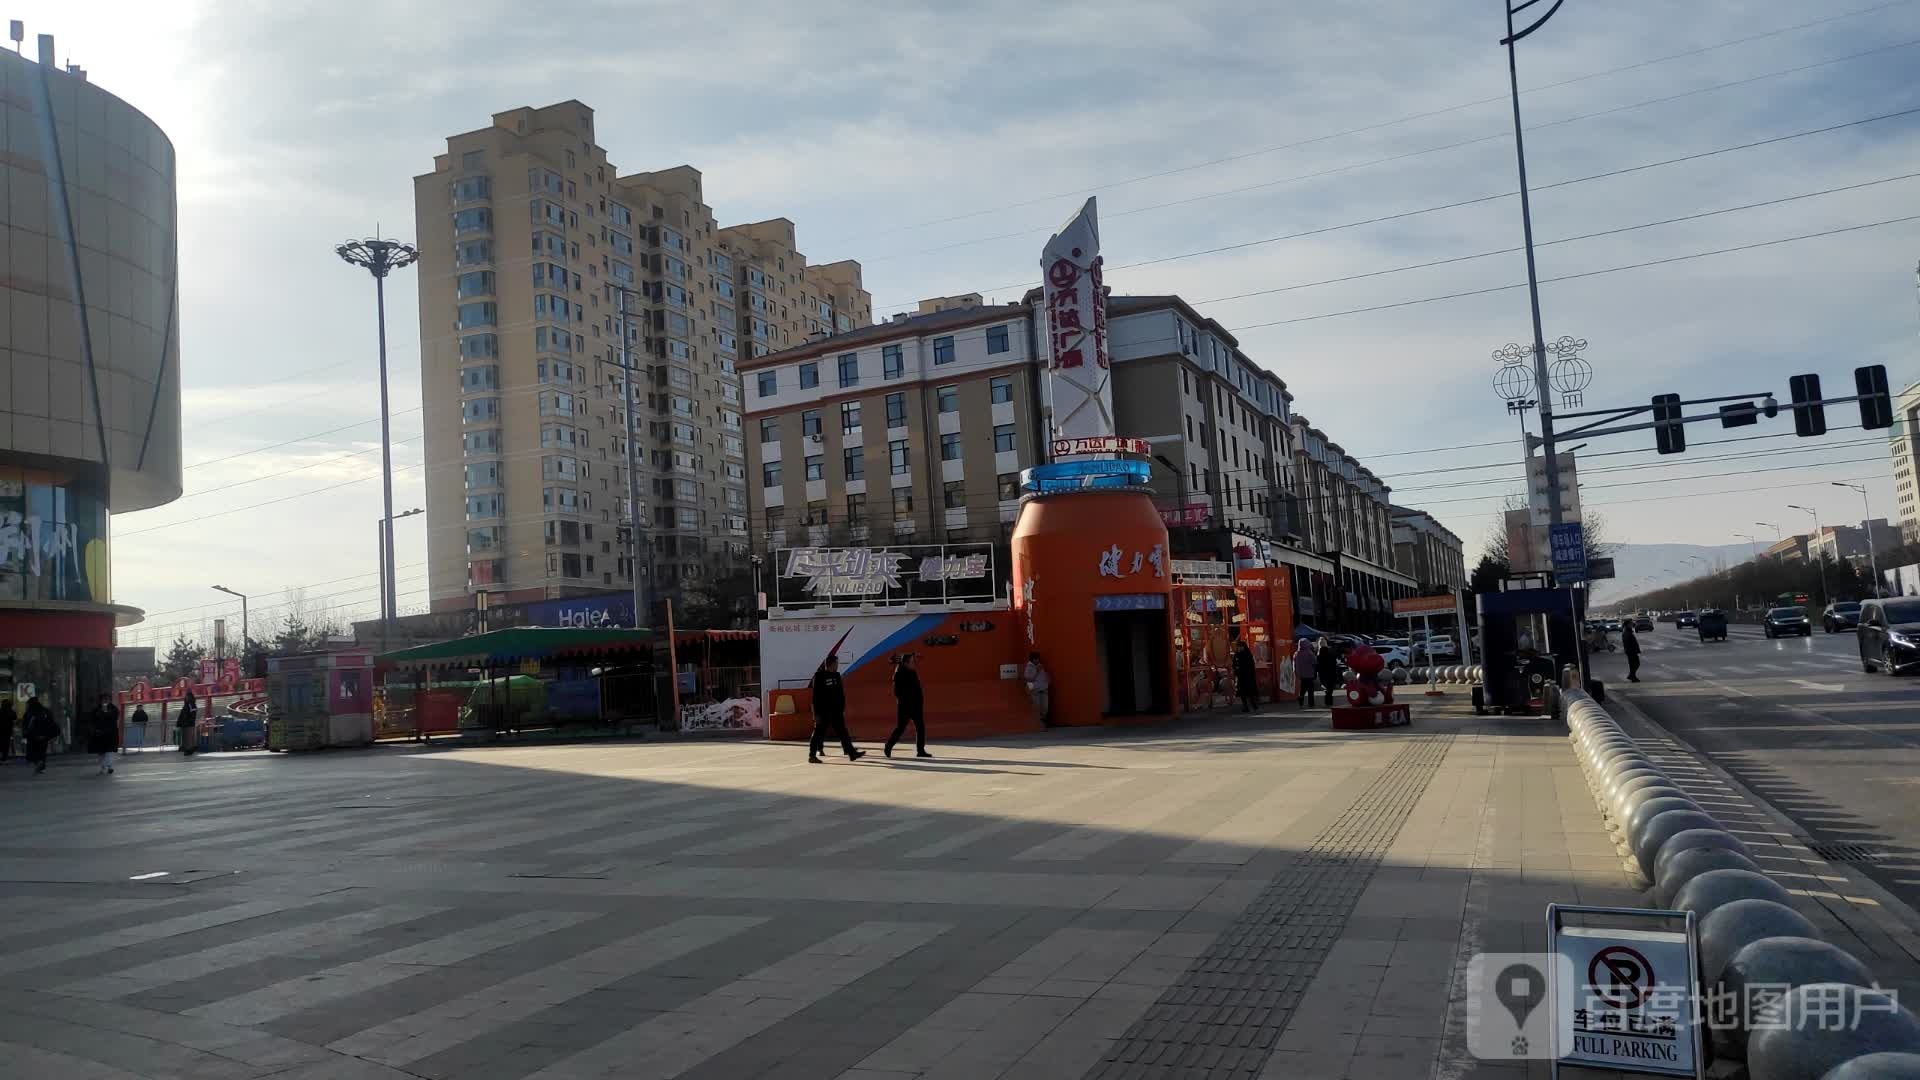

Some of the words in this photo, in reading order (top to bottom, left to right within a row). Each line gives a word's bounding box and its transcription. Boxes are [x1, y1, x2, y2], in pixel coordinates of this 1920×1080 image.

[1573, 1008, 1677, 1037] 车位已满
[1573, 1035, 1610, 1055] FULL
[1613, 1039, 1678, 1062] PARKING
